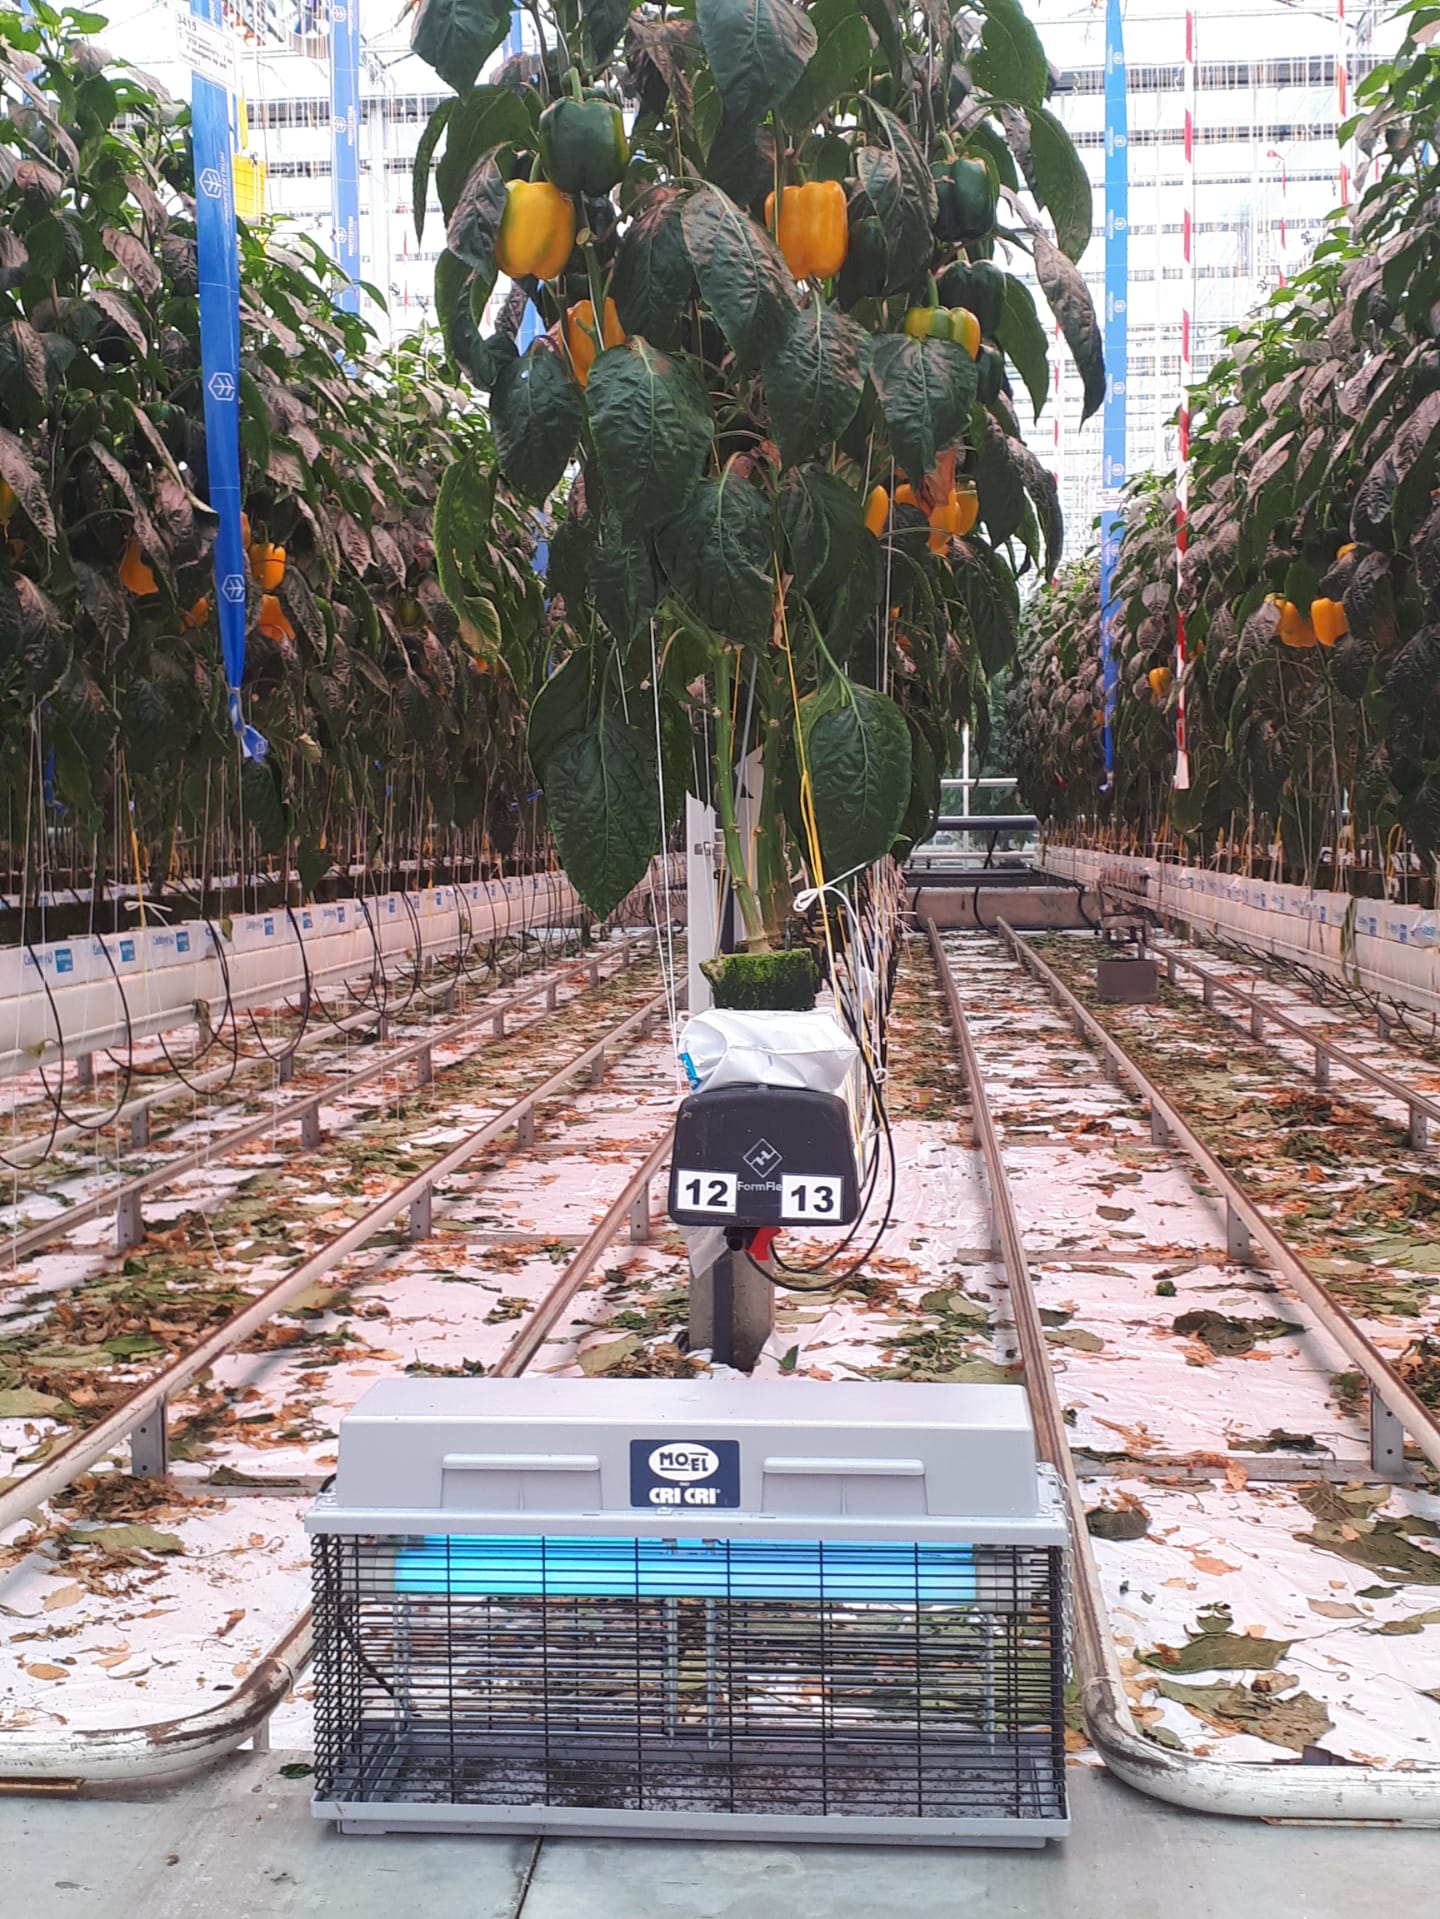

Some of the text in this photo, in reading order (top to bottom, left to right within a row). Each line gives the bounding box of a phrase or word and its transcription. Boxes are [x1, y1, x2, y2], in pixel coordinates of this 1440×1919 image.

[685, 1178, 729, 1207] 12
[737, 1181, 783, 1191] FormFle
[790, 1185, 834, 1213] 13
[659, 1452, 709, 1471] MOEL
[649, 1487, 681, 1504] CRI
